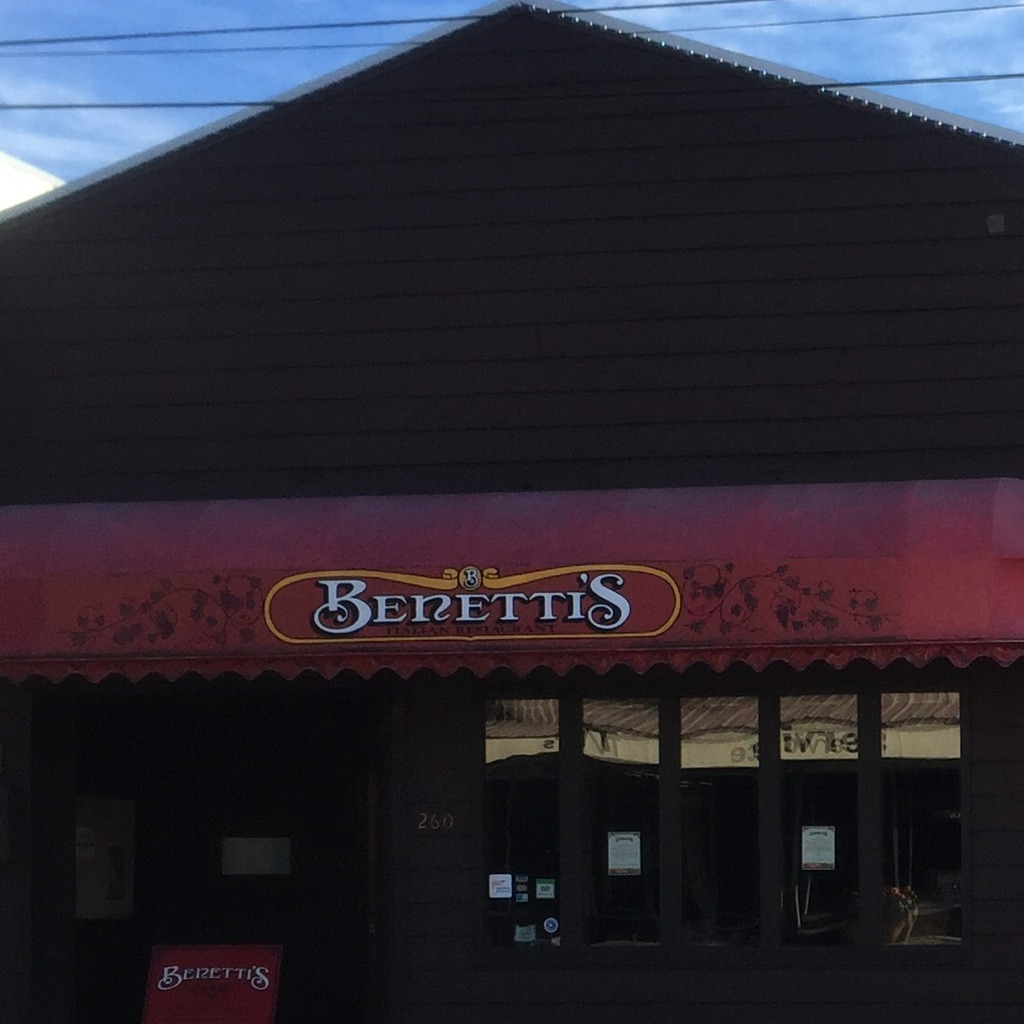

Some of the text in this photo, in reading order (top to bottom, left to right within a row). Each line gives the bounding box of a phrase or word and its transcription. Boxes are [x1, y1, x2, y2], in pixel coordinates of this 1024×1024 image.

[312, 572, 632, 634] BENETTI'S
[386, 625, 557, 635] ITALIAN RESTAURANT
[418, 812, 454, 830] 260
